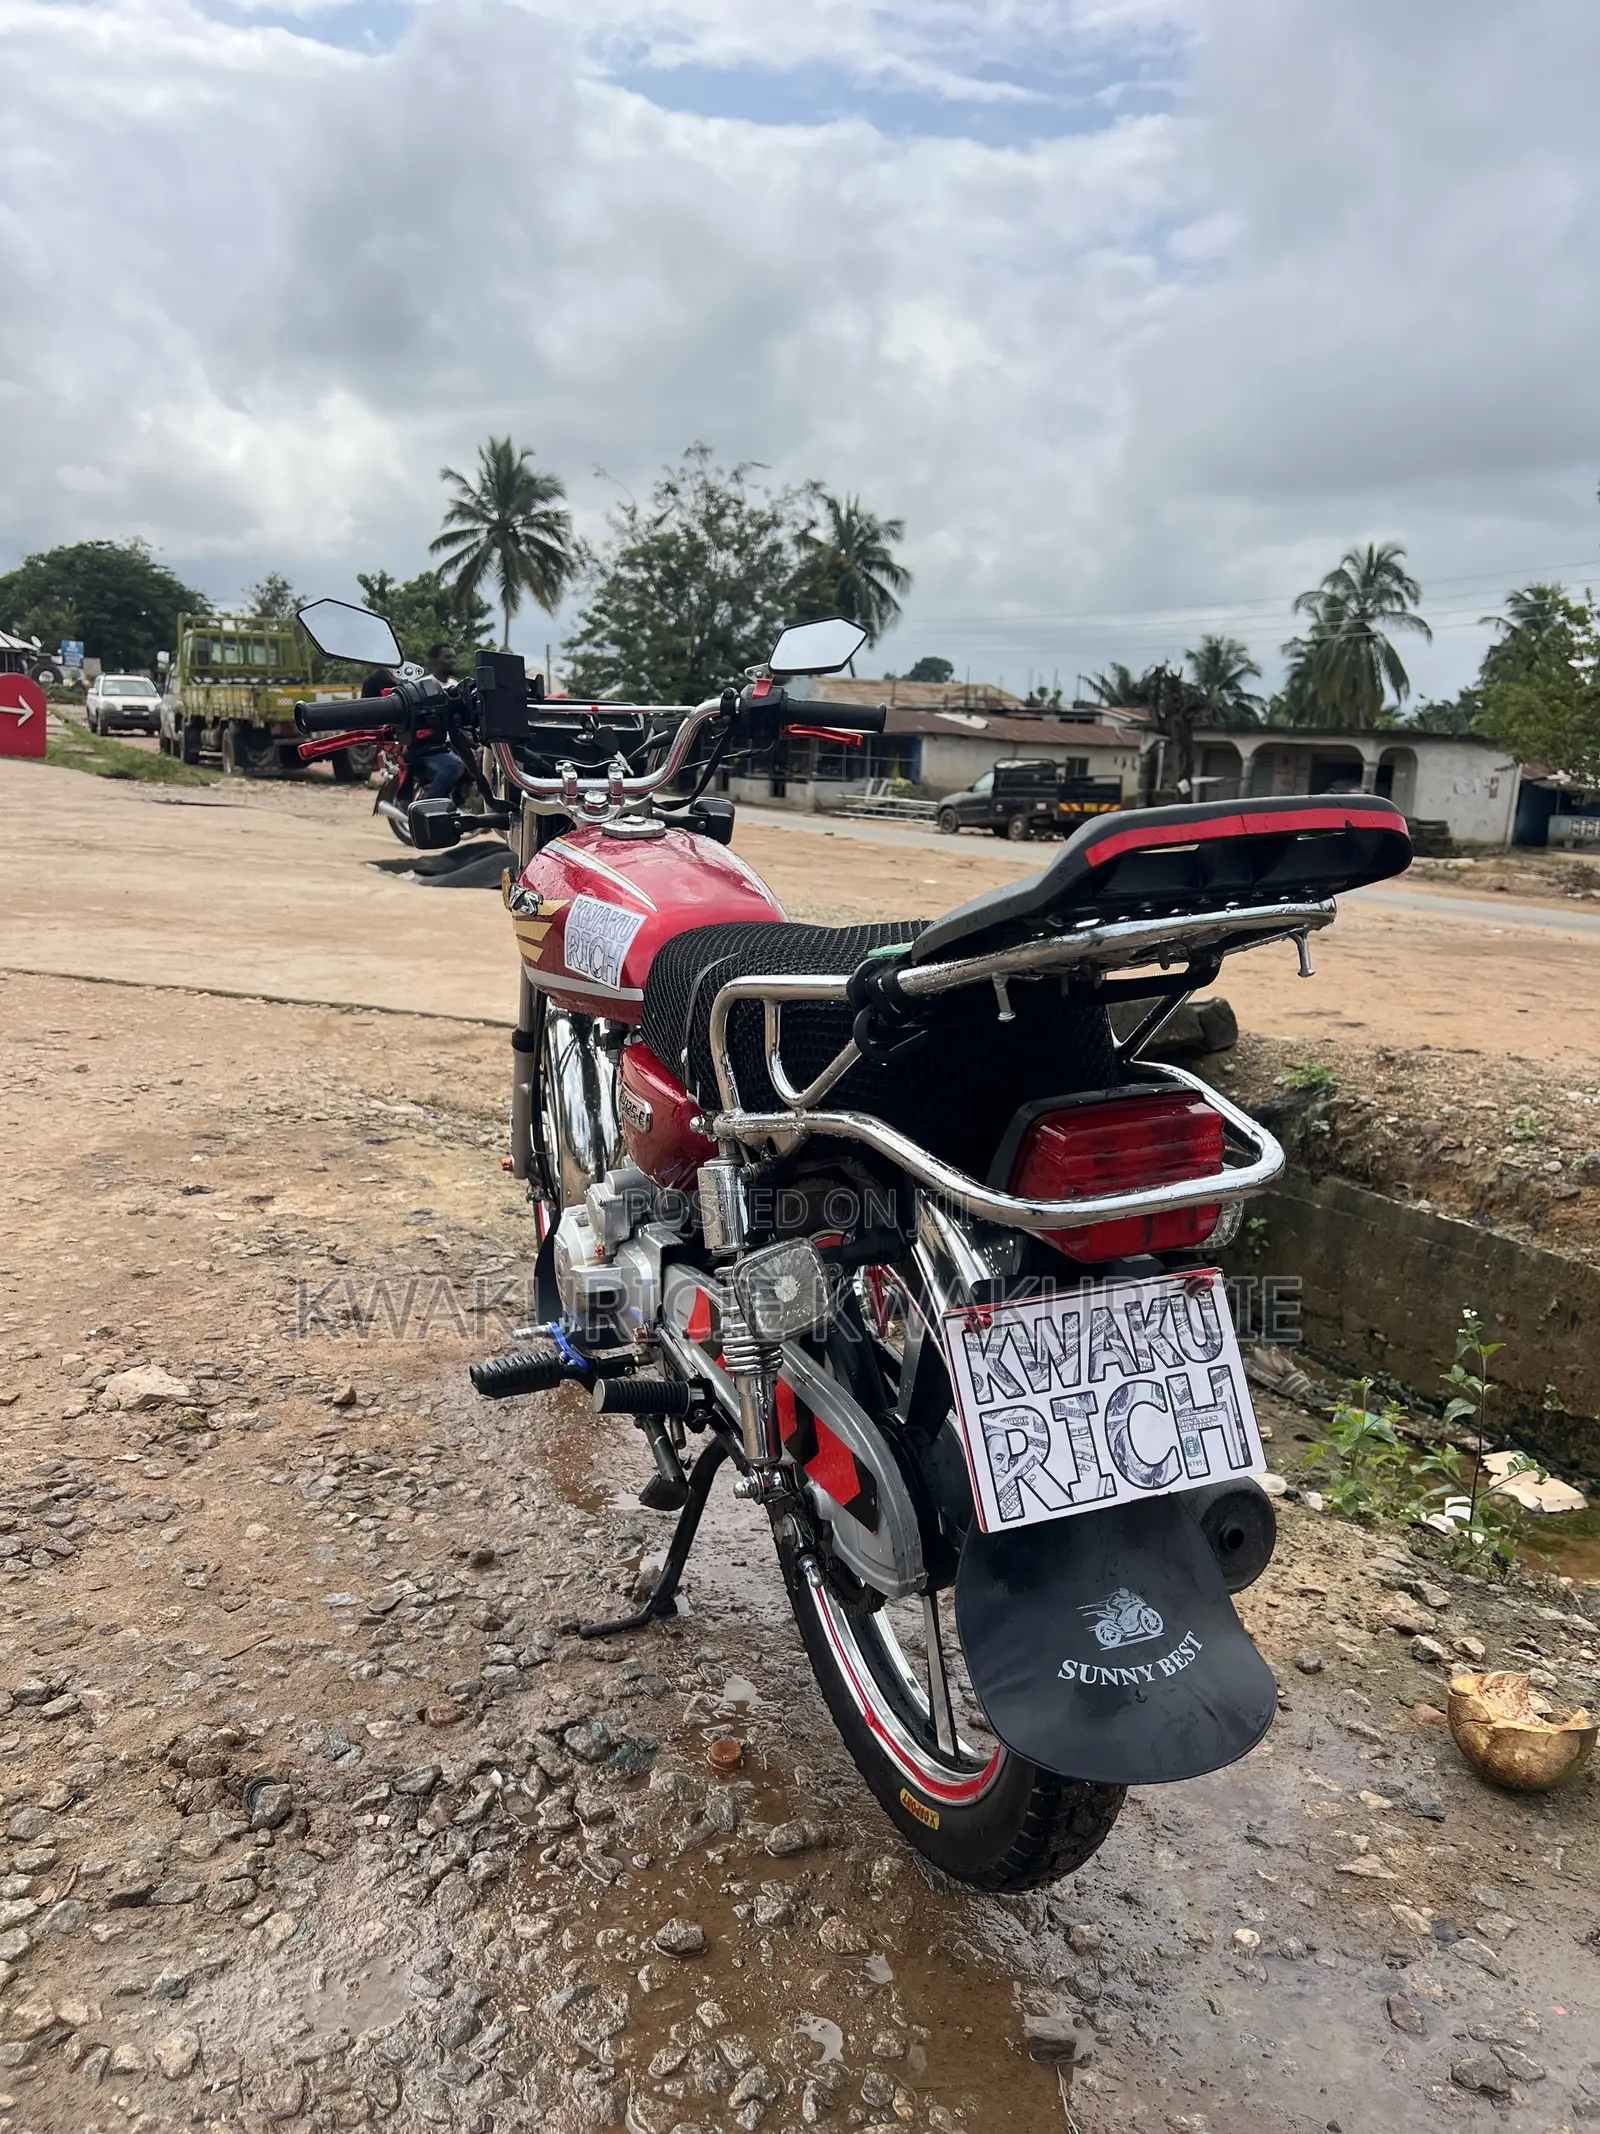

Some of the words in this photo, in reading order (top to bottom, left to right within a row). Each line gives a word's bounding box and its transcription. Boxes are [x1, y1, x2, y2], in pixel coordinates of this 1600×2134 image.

[569, 899, 640, 943] KWAKU
[566, 926, 625, 987] RICH
[961, 1291, 1225, 1405] KWAKU
[979, 1365, 1253, 1523] RICH
[1057, 1659, 1156, 1686] SUNNY
[1156, 1630, 1203, 1678] BEST
